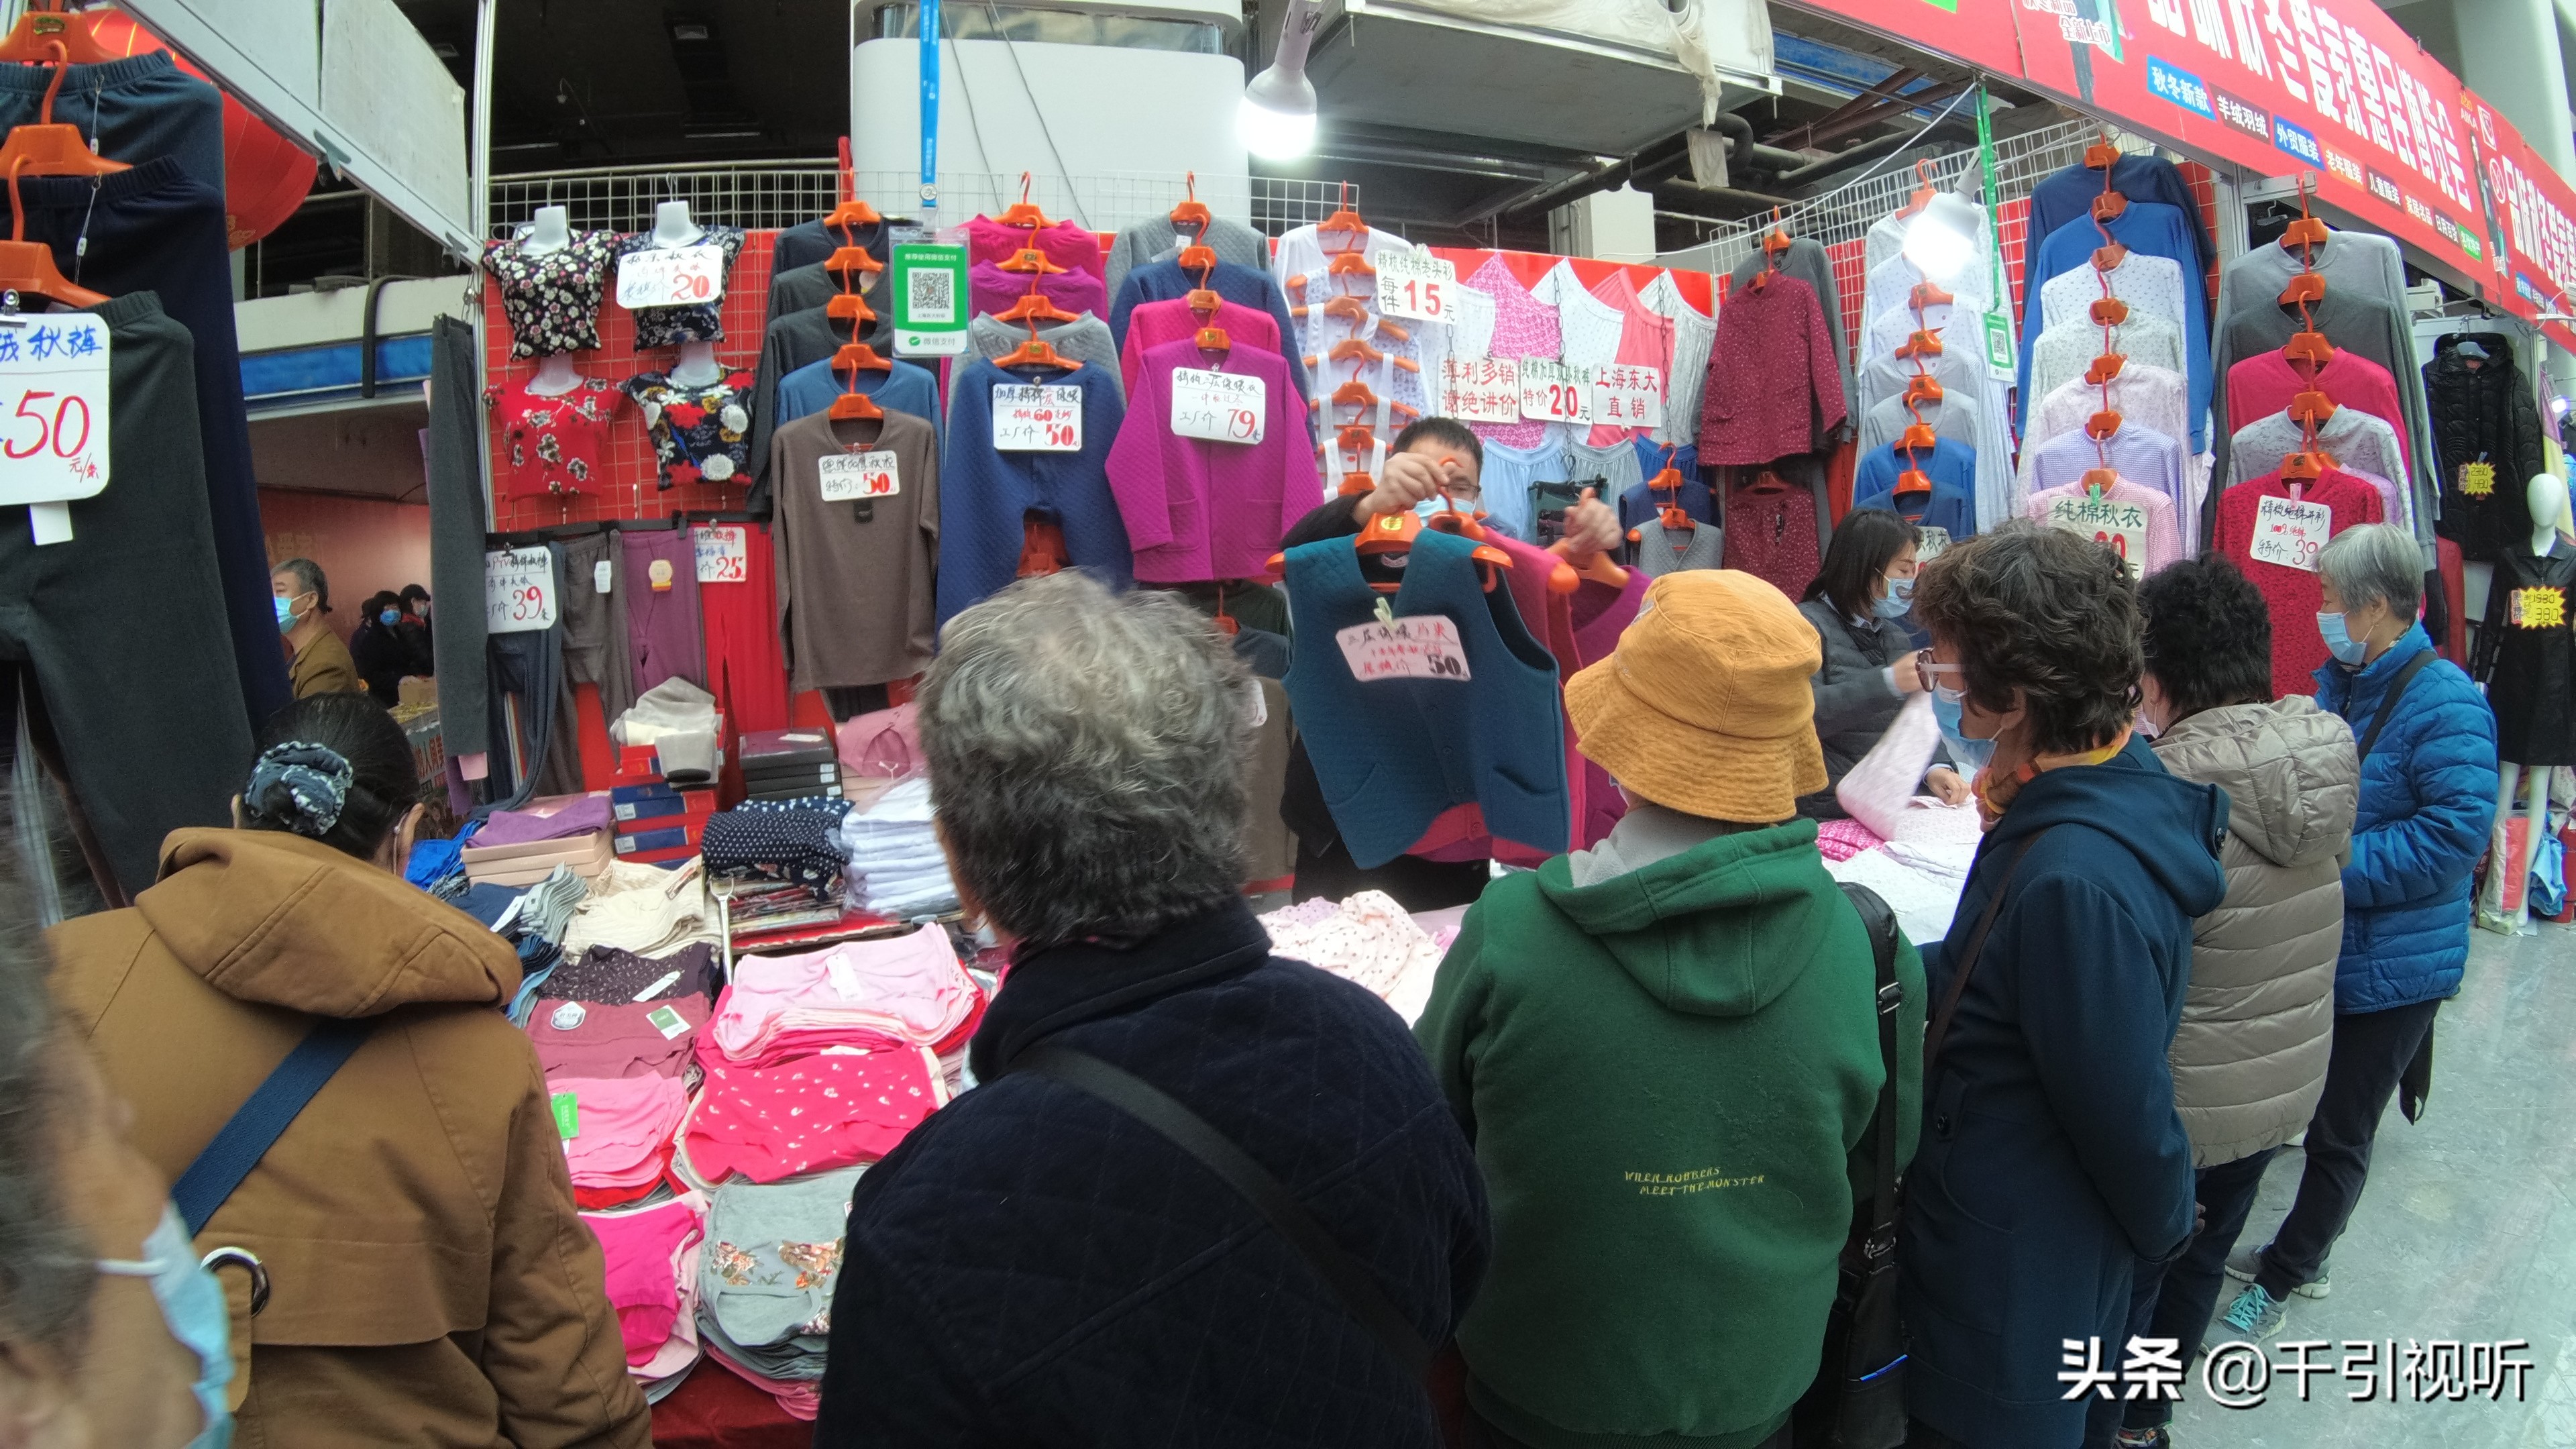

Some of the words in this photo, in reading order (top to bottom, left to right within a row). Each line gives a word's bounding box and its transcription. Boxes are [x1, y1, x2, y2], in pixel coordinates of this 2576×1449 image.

[2151, 66, 2211, 113] 秋冬新款
[2216, 95, 2269, 138] 羊绒羽绒
[2276, 122, 2320, 163] 外贸服装
[2325, 149, 2363, 186] 老年服装
[2368, 172, 2402, 206] 儿童服装
[671, 273, 710, 303] 20
[1381, 275, 1401, 313] 每件
[1403, 279, 1441, 316] 15
[923, 336, 956, 347] 微信支付
[1442, 357, 1515, 387] 薄利多销
[1595, 366, 1658, 394] 上海东大
[1442, 388, 1517, 418] 谢绝讲价
[1607, 396, 1646, 421] 直销
[3, 389, 91, 460] 50
[1044, 423, 1075, 447] 50
[1227, 409, 1256, 439] 79
[862, 472, 891, 494] 50
[2054, 499, 2143, 529] 纯棉秋衣
[715, 555, 743, 580] 25
[512, 585, 543, 622] 39
[2535, 607, 2559, 621] 380
[1426, 653, 1462, 676] 50
[1638, 1185, 1676, 1196] MEET
[1707, 1174, 1766, 1189] MONSTER
